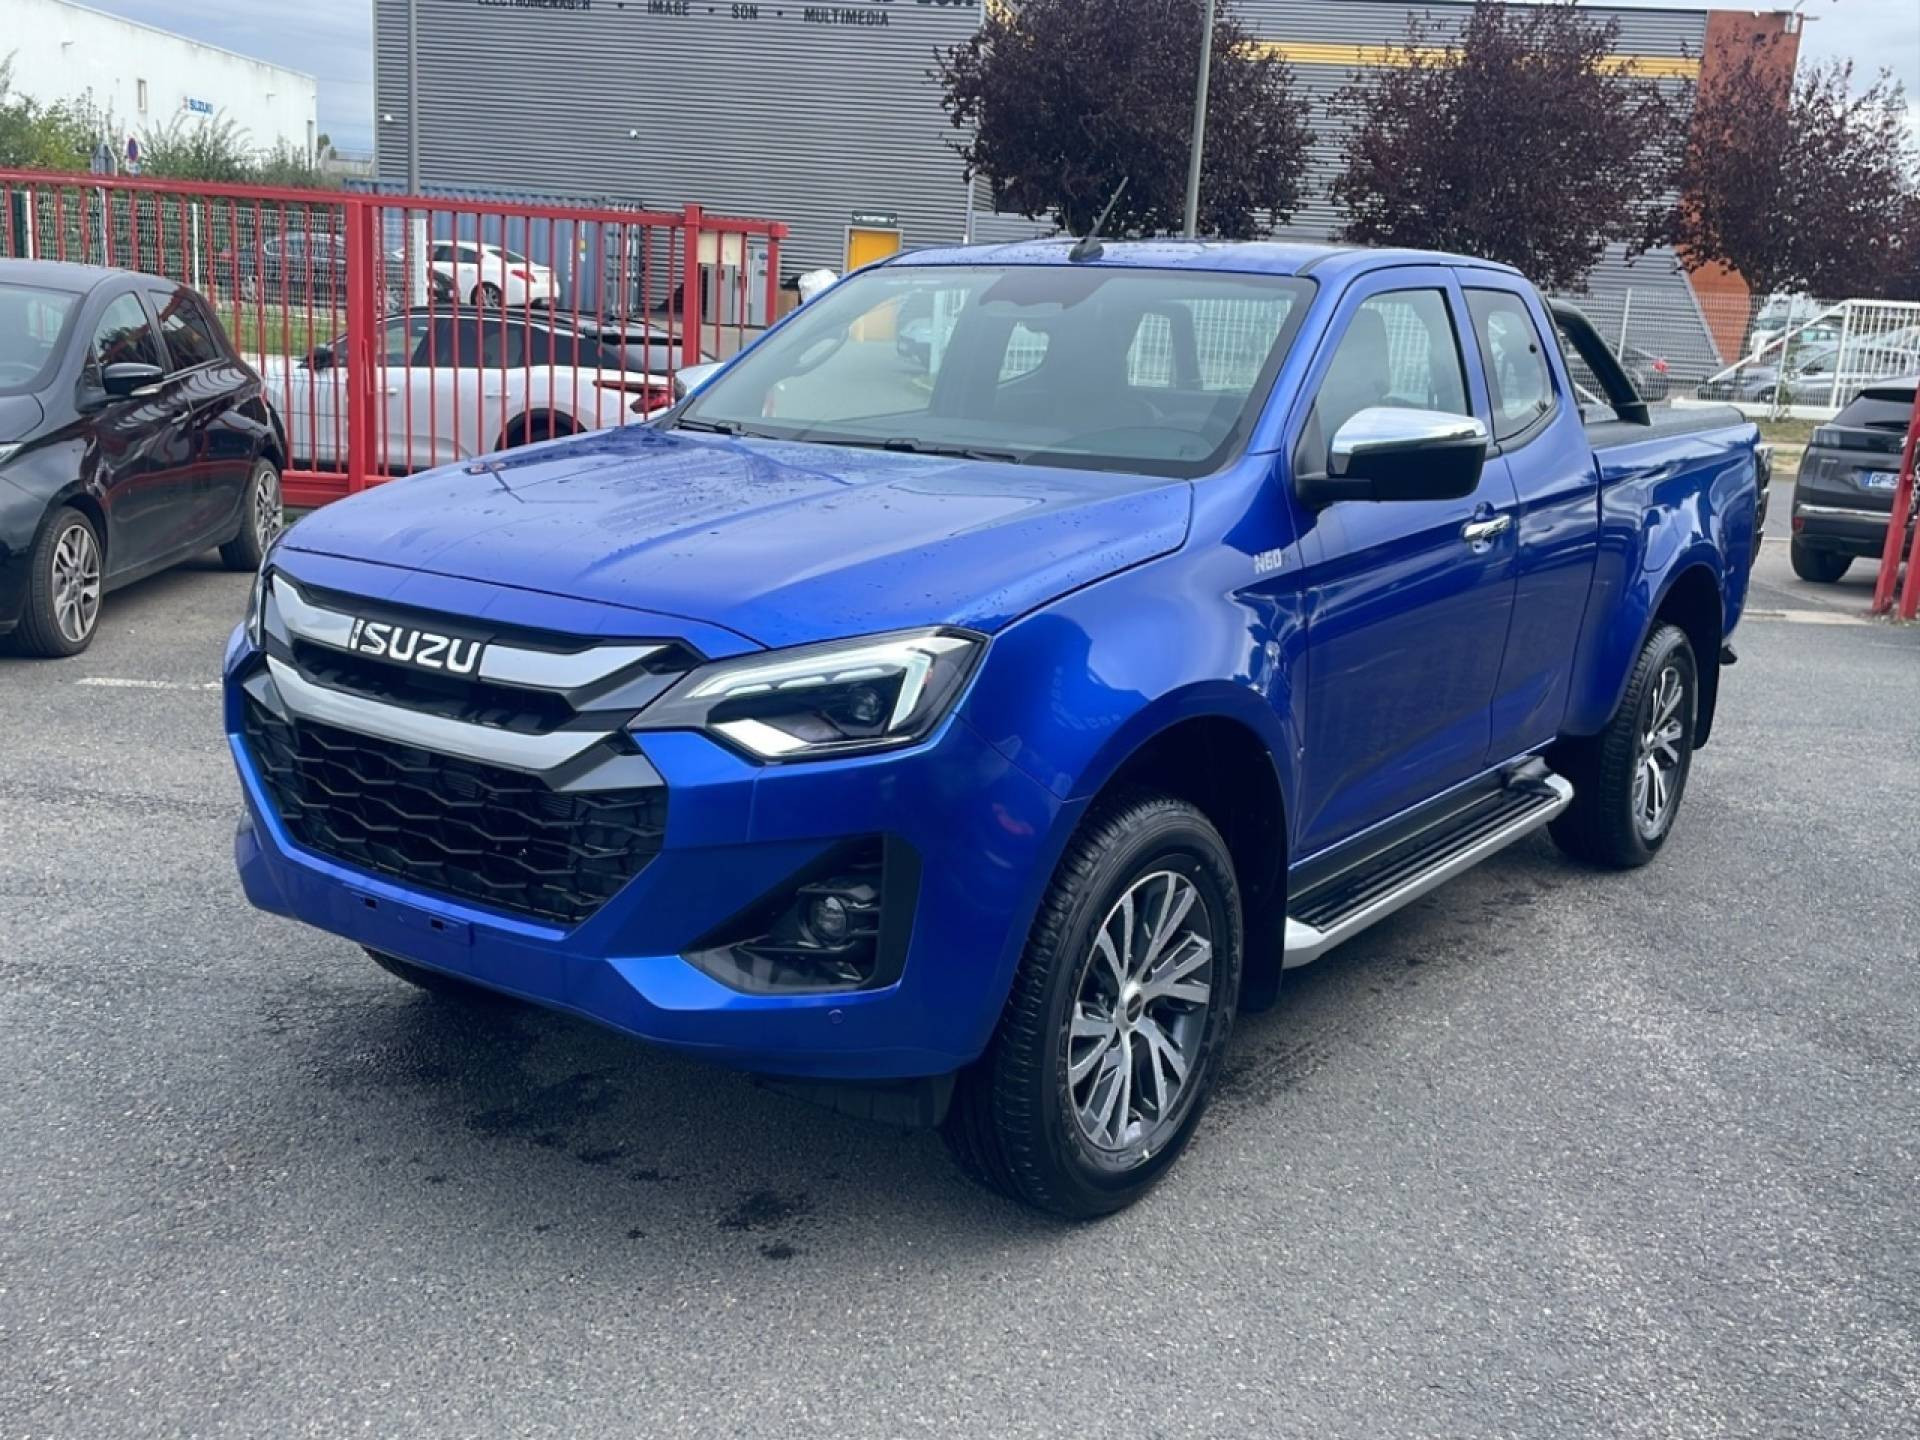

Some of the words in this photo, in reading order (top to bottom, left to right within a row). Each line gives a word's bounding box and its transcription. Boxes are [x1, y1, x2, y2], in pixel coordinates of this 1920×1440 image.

[647, 0, 690, 16] IMAGE
[731, 4, 758, 19] SON
[803, 8, 888, 26] MULTIMEDIA
[350, 619, 481, 673] ISUZU
